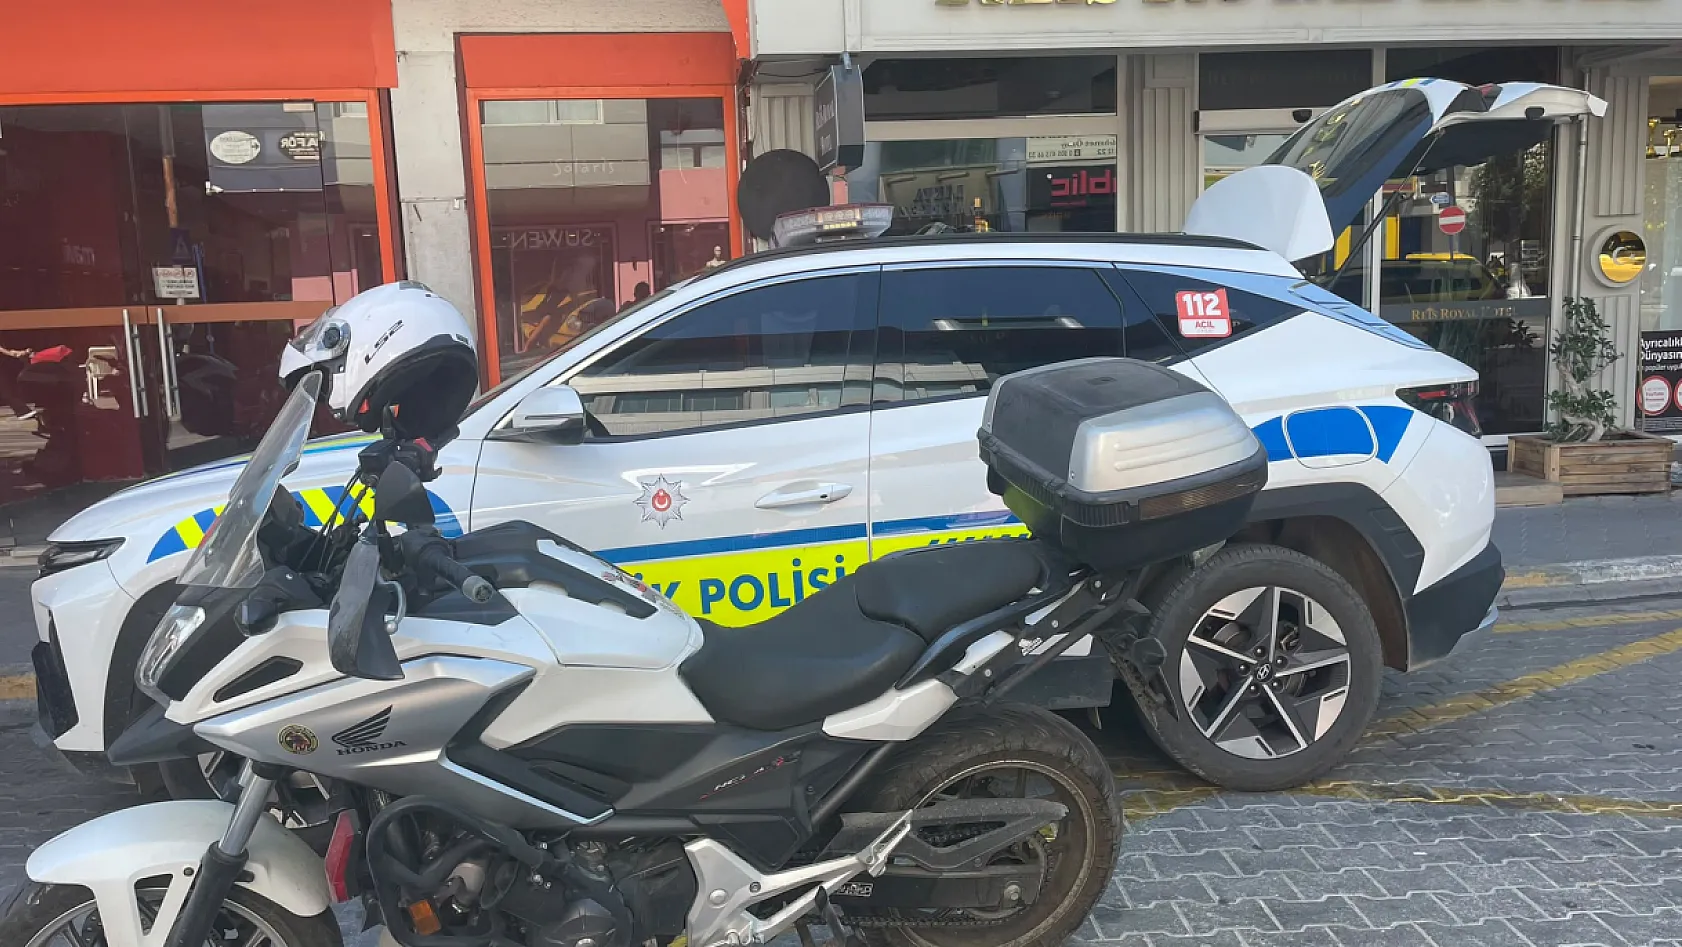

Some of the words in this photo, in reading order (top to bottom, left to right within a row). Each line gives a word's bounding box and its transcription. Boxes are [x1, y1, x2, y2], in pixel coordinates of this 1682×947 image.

[1182, 293, 1222, 316] 112
[364, 319, 405, 365] LS2
[336, 740, 407, 755] HONDA
